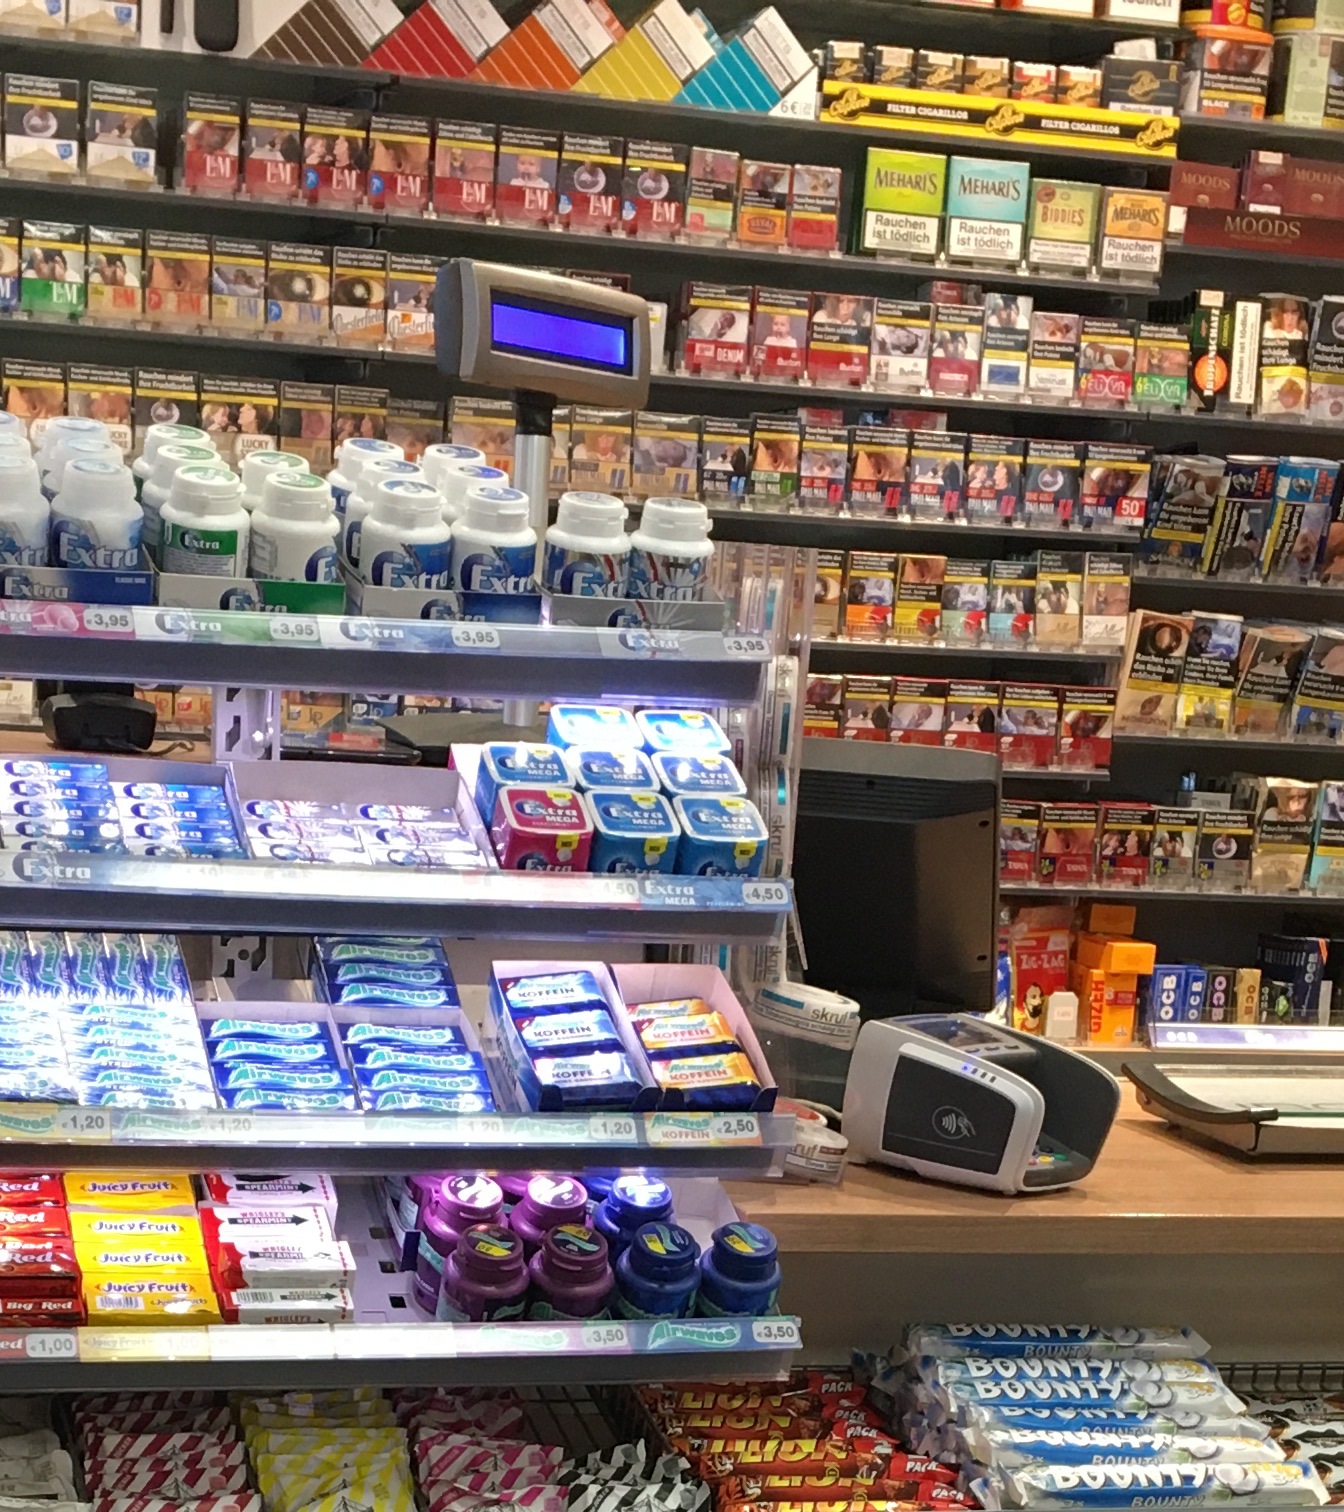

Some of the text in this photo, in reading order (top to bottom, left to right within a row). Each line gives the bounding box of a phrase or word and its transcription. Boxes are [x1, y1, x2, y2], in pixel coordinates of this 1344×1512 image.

[887, 103, 968, 119] FILTER CIGARILLOS
[874, 167, 938, 195] MEHARI'S
[958, 174, 1021, 201] MEHARI'S
[875, 215, 927, 230] Rauchen
[1041, 204, 1084, 225] BIDDIES
[872, 227, 930, 244] ist tödlich
[1224, 216, 1301, 238] MOODS
[59, 532, 138, 568] Extra
[519, 987, 575, 999] KOFFEIN
[1160, 975, 1176, 1022] OCB
[1089, 978, 1102, 1033] GIZEH
[652, 1028, 712, 1039] KOFFEIN
[88, 1180, 170, 1193] Juicy Fruit
[649, 1323, 740, 1346] Airwaves
[967, 1358, 1116, 1379] BOUNTY
[1051, 1464, 1211, 1489] BOUNTY
